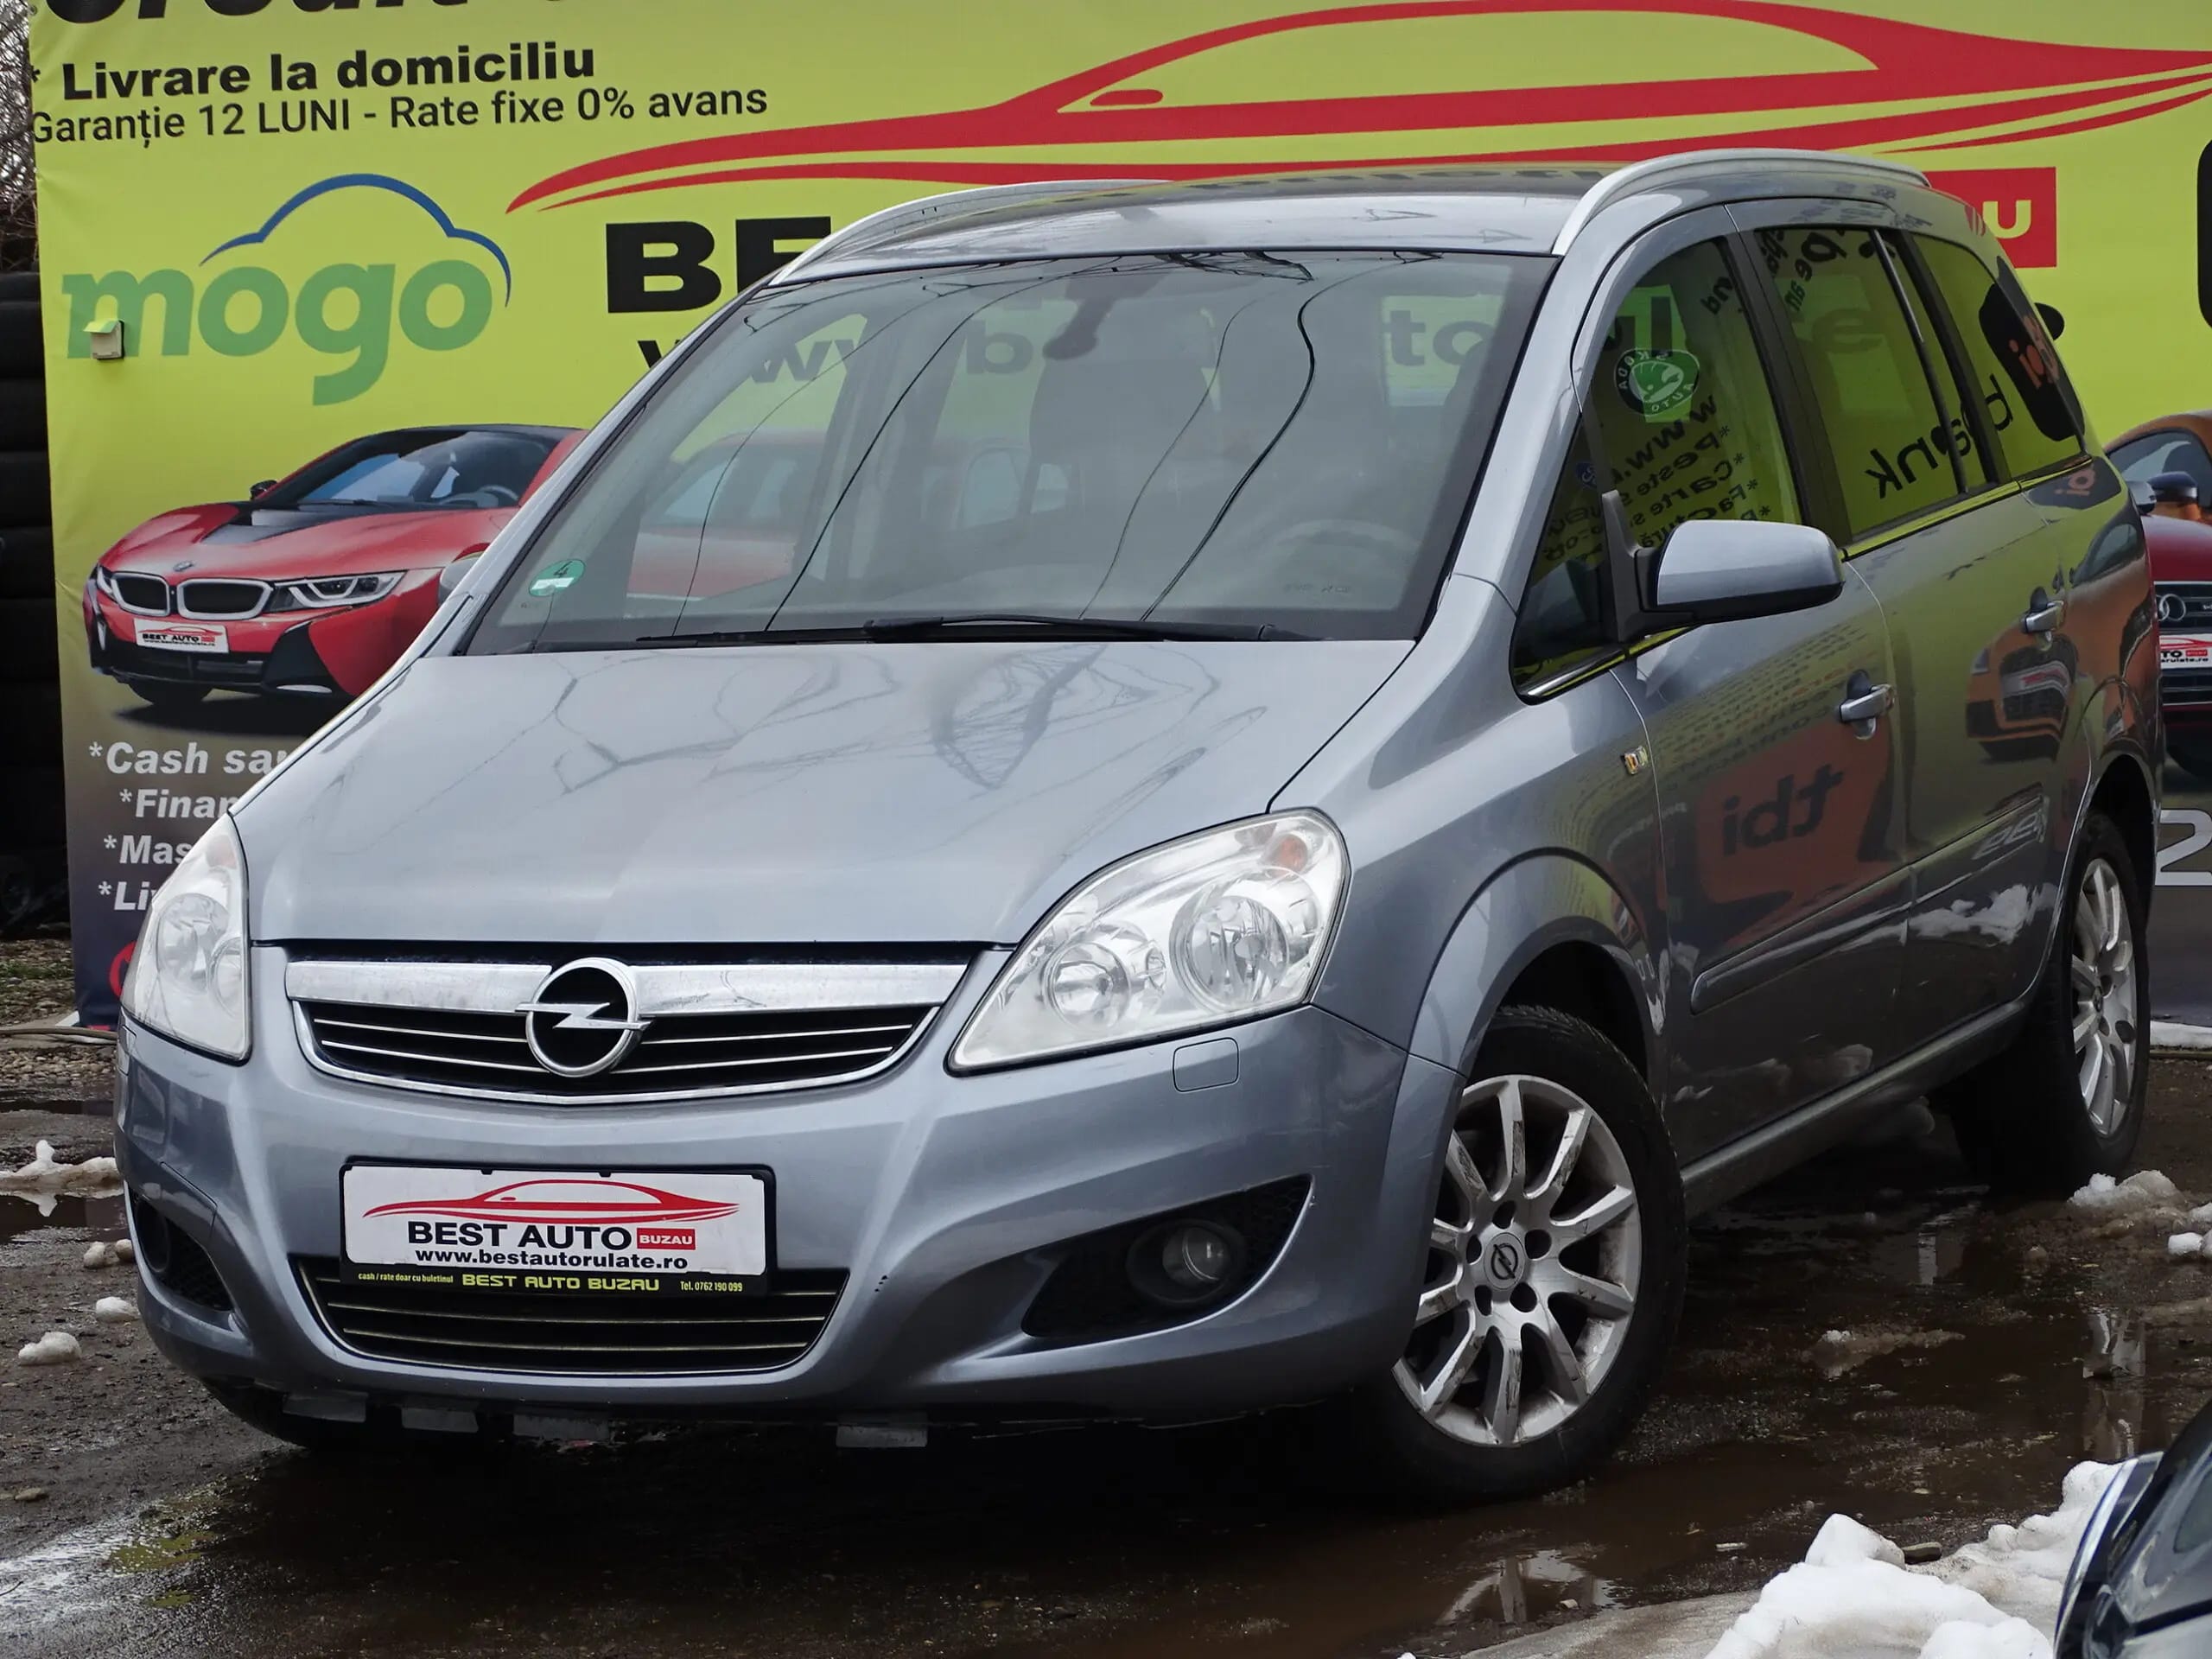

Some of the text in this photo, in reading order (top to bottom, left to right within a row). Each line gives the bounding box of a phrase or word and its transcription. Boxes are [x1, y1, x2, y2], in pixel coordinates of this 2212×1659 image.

[63, 41, 594, 100] Livrare la domiciliu
[32, 104, 185, 149] Garanție
[199, 103, 245, 136] 12
[258, 99, 349, 133] LUNI
[391, 96, 479, 128] Rate
[491, 90, 564, 124] fixe
[578, 87, 634, 120] 0%
[648, 88, 767, 118] avans
[61, 261, 493, 406] mogo
[408, 1221, 692, 1249] BEST AUTO BUZAU
[416, 1249, 688, 1269] www.bestautorulate.ro
[396, 1273, 411, 1281] doar
[423, 1274, 454, 1283] buletinul
[462, 1274, 518, 1287] BEST
[525, 1276, 581, 1289] AUTO
[588, 1278, 659, 1291] BUZAU
[680, 1281, 693, 1291] Tel.
[695, 1281, 713, 1291] 0762
[715, 1282, 726, 1291] 190
[728, 1282, 742, 1292] 099
